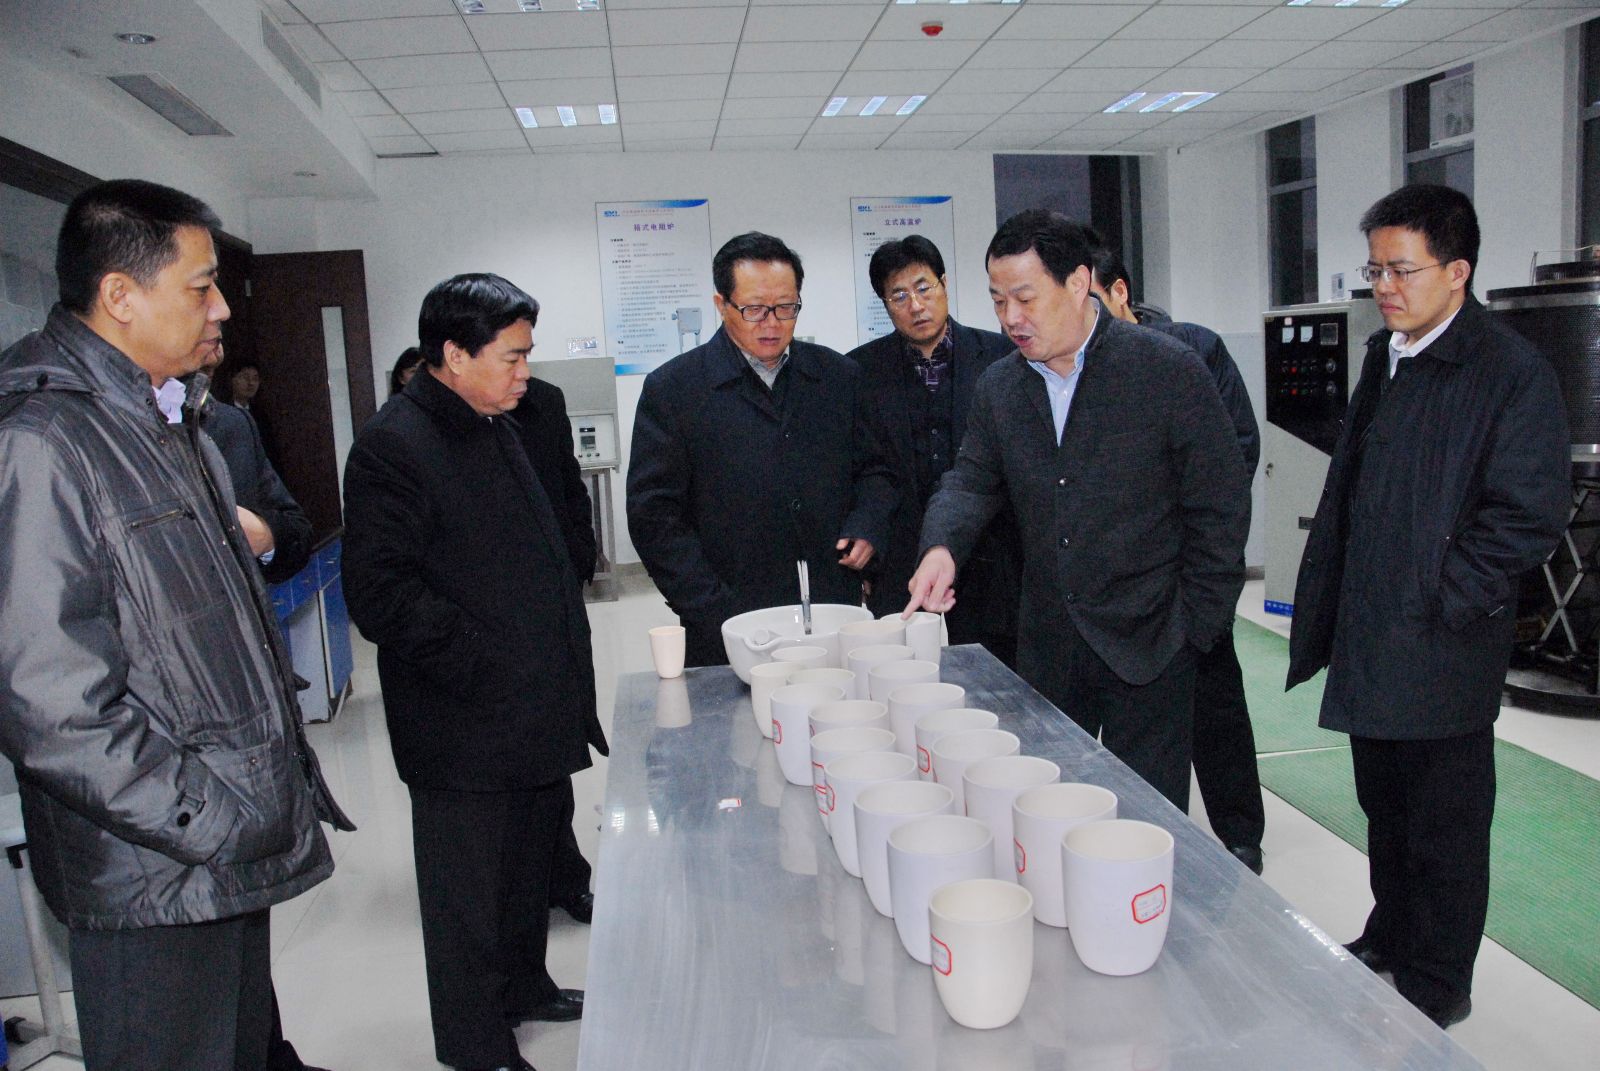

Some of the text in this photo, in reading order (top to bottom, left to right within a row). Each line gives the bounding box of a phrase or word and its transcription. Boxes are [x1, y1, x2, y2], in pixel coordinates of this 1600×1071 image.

[633, 222, 675, 232] 箱式电阻炉
